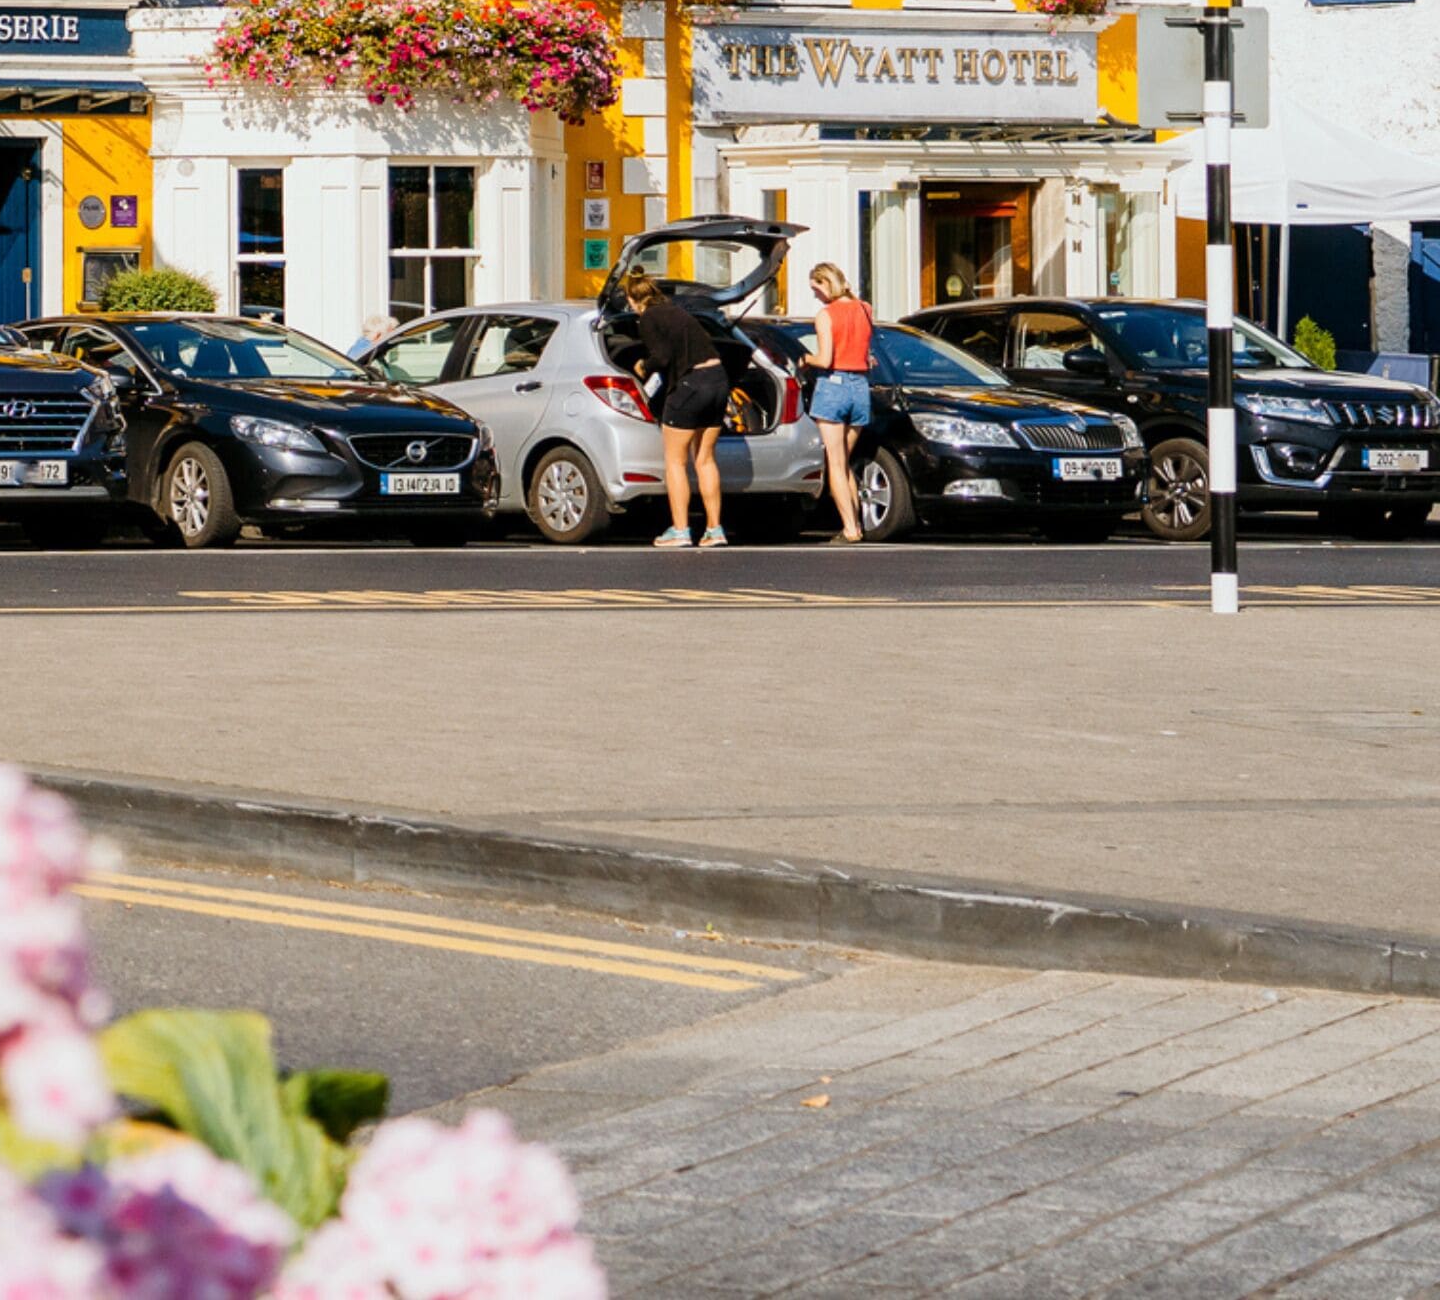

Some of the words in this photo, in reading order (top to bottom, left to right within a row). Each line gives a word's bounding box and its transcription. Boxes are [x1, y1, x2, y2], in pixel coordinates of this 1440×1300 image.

[723, 43, 800, 78] THE
[802, 38, 944, 88] WYATT
[953, 48, 1079, 84] HOTEL
